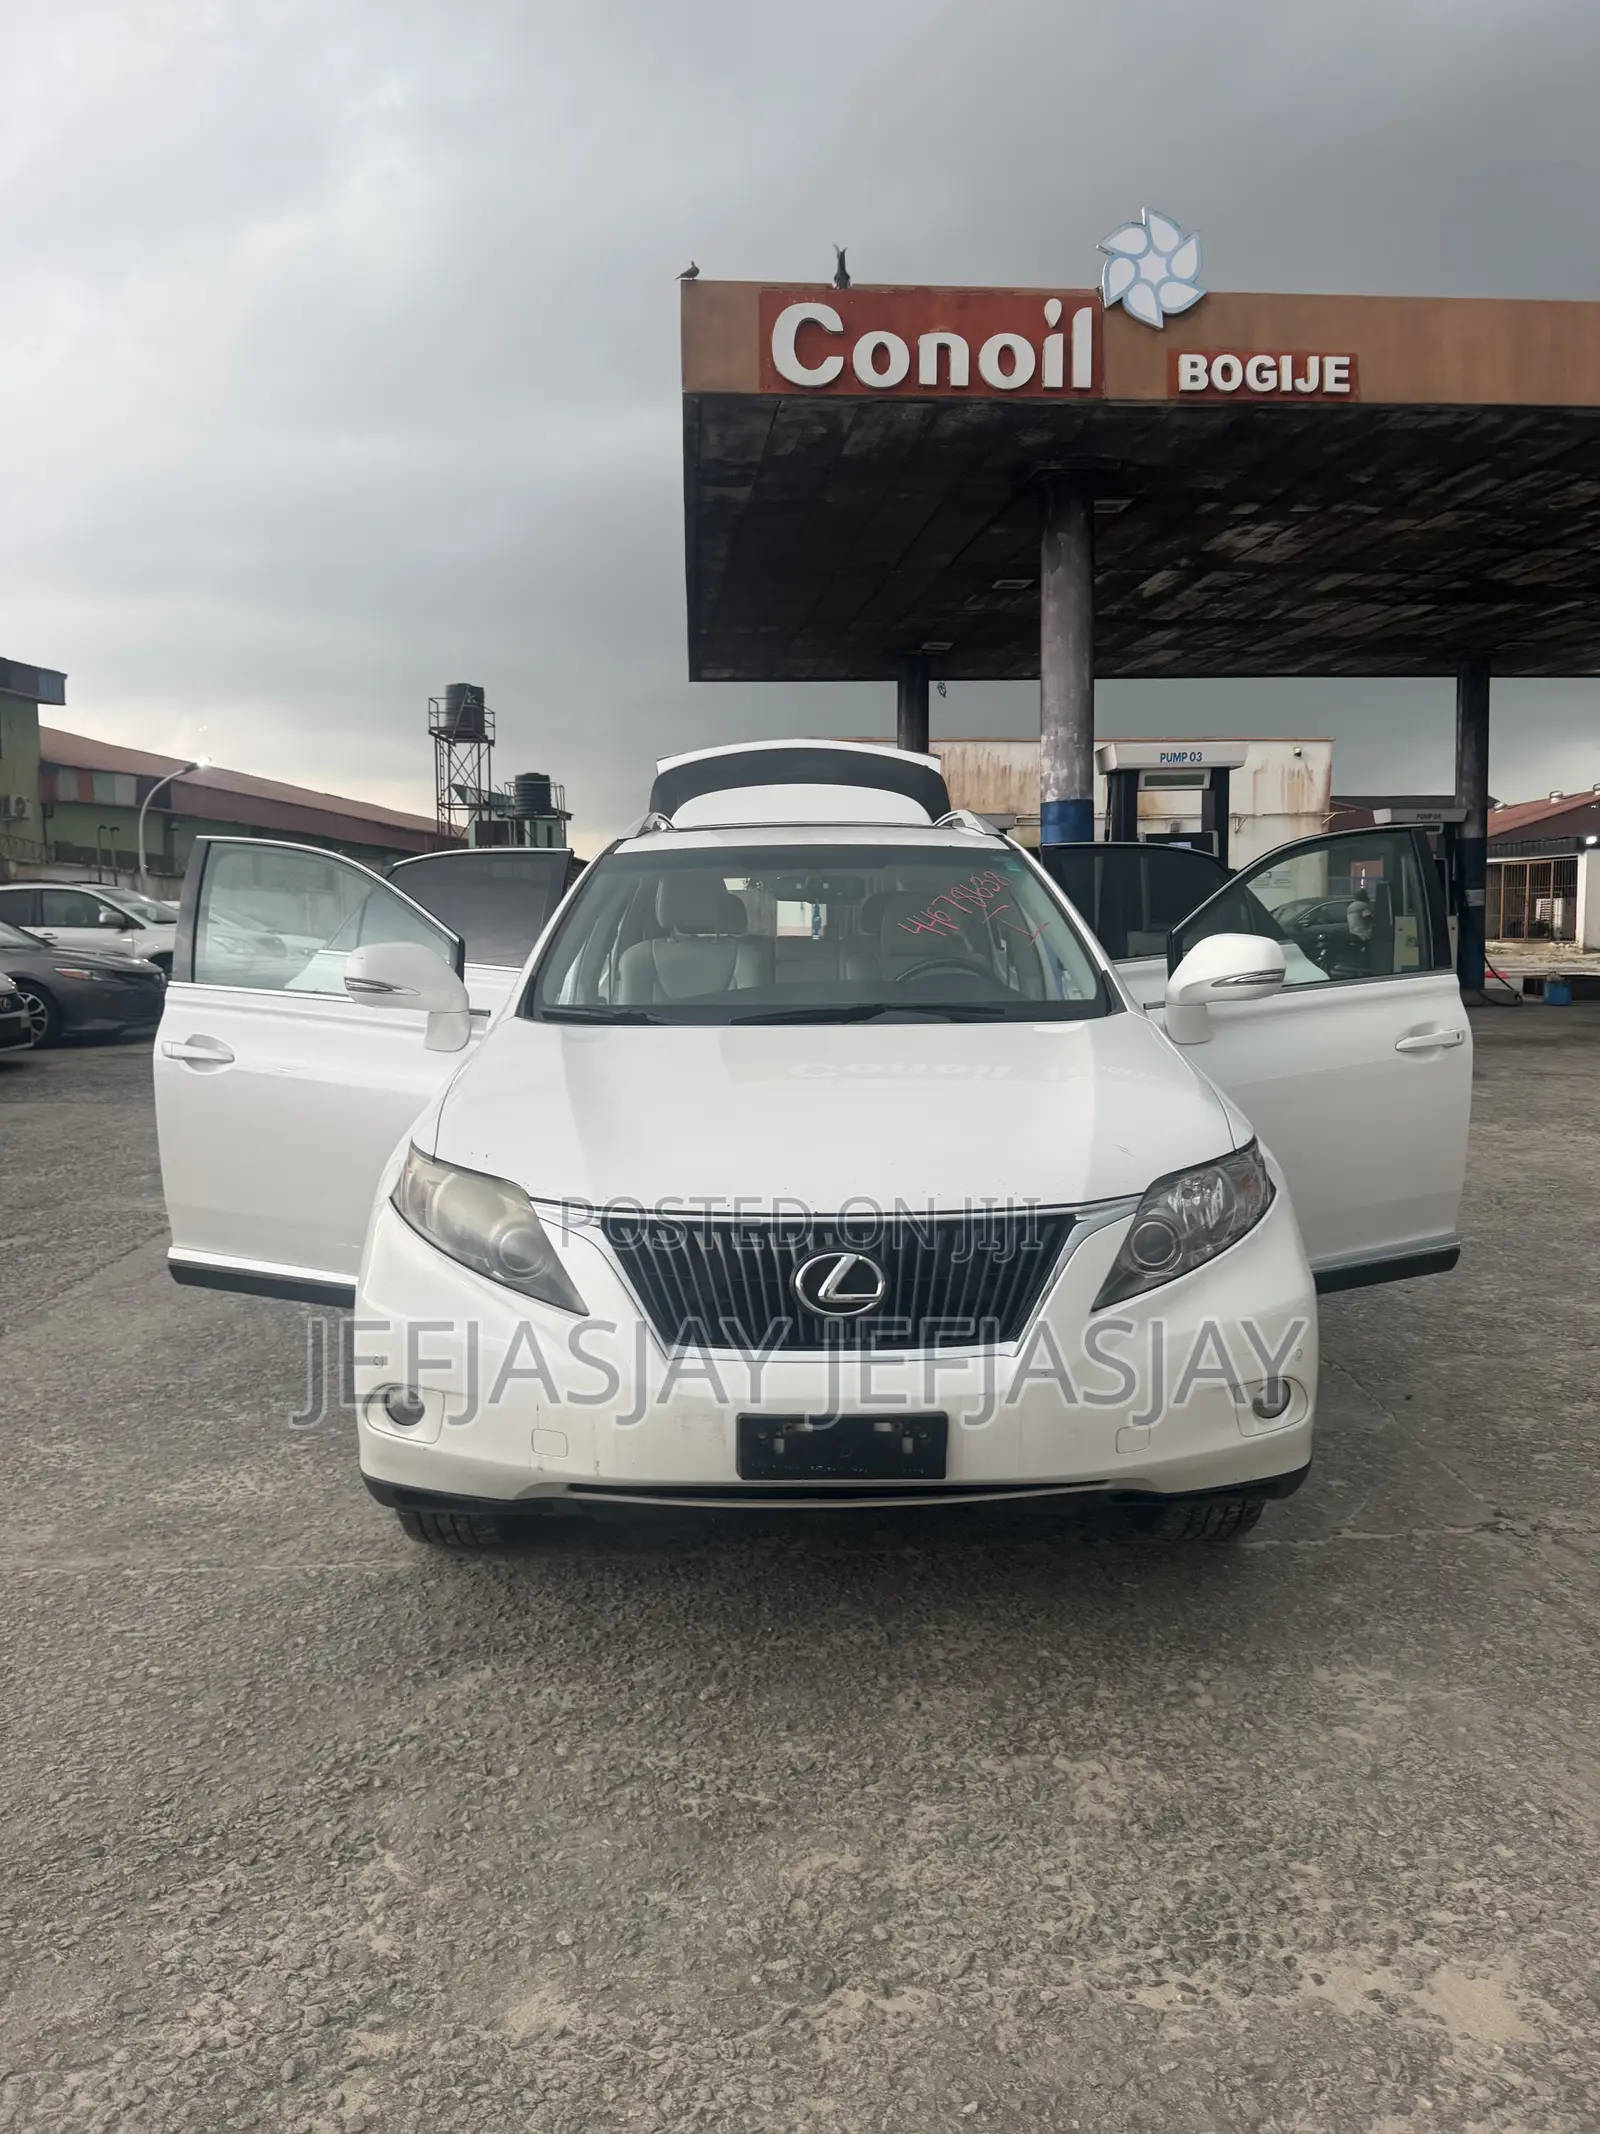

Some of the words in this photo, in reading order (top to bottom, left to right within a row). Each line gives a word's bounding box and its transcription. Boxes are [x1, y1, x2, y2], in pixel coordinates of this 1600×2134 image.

[771, 298, 1092, 389] Conoil
[1178, 353, 1351, 394] BOGIJE
[1160, 752, 1187, 763] PUMP
[1189, 752, 1203, 763] 03
